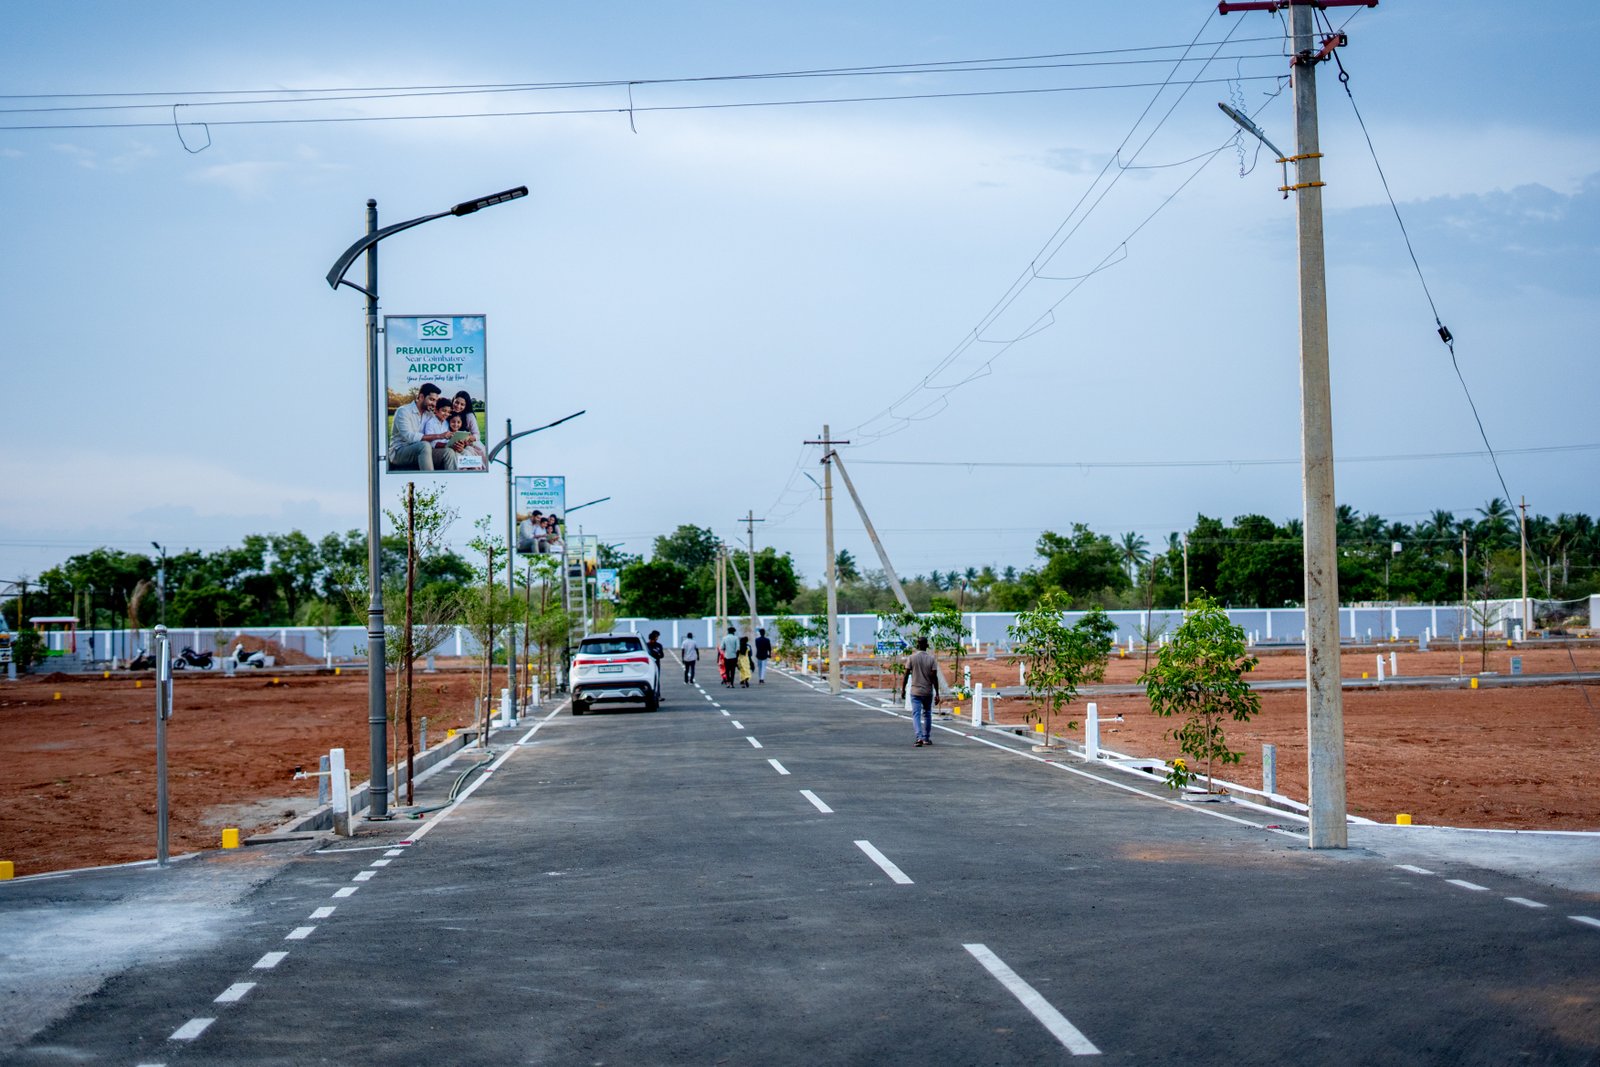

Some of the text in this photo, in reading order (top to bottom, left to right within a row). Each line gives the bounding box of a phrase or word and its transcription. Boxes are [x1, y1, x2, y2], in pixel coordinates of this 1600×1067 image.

[422, 325, 448, 336] SKS
[396, 346, 474, 354] PREMIUM PLOTS
[408, 363, 463, 372] AIRPORT
